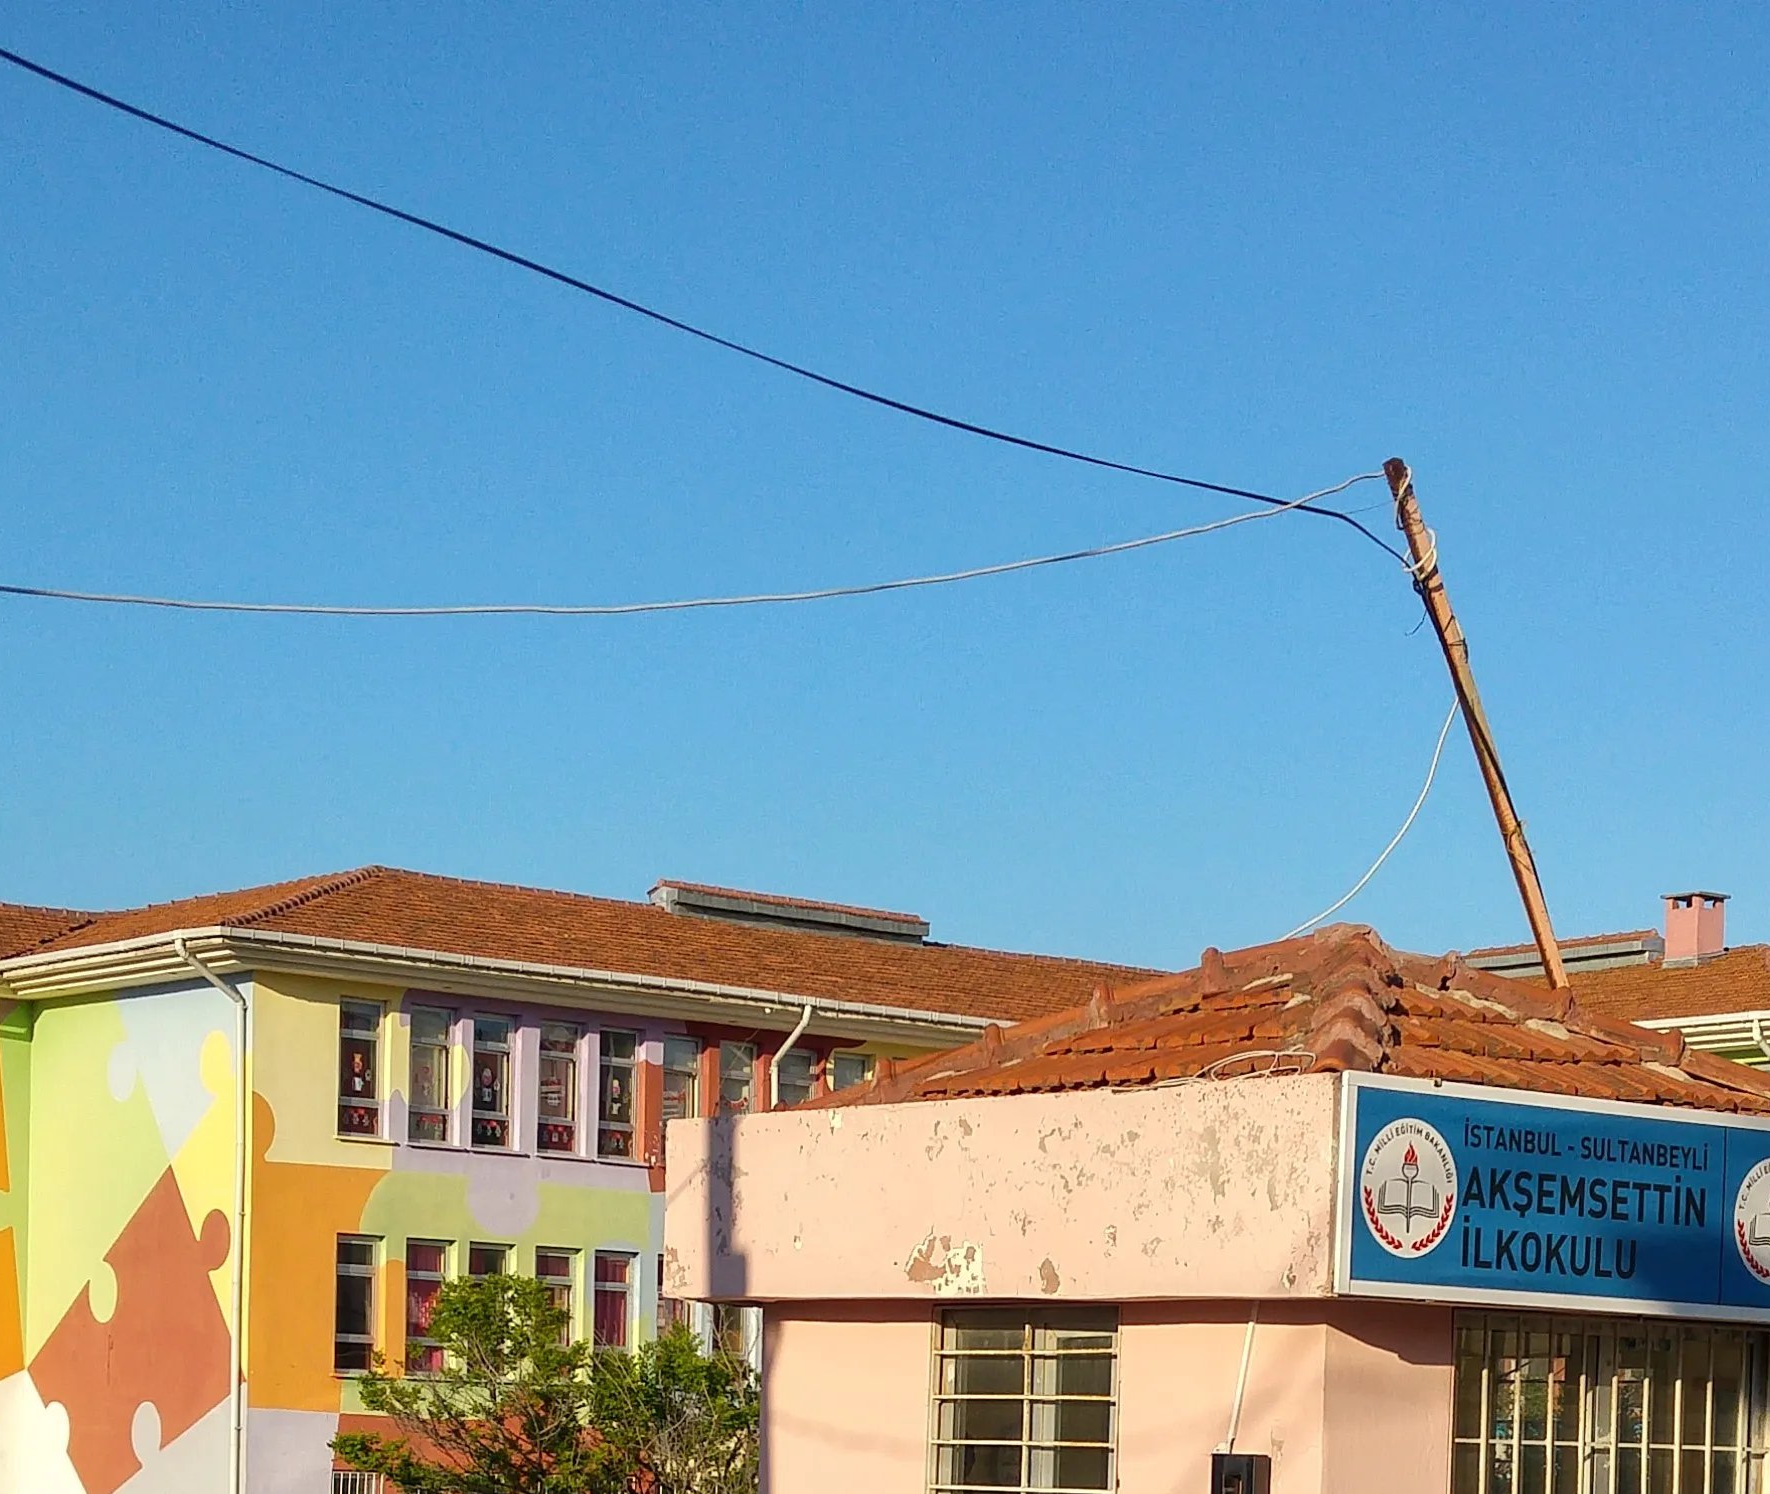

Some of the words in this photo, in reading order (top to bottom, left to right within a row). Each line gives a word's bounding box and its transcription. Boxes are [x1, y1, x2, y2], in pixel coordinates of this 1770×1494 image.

[1464, 1117, 1562, 1157] İSTANBUL
[1581, 1136, 1708, 1171] SULTANBEYLİ
[1461, 1166, 1706, 1228] AKŞEMSETTİN
[1461, 1215, 1637, 1280] İLKOKULU
